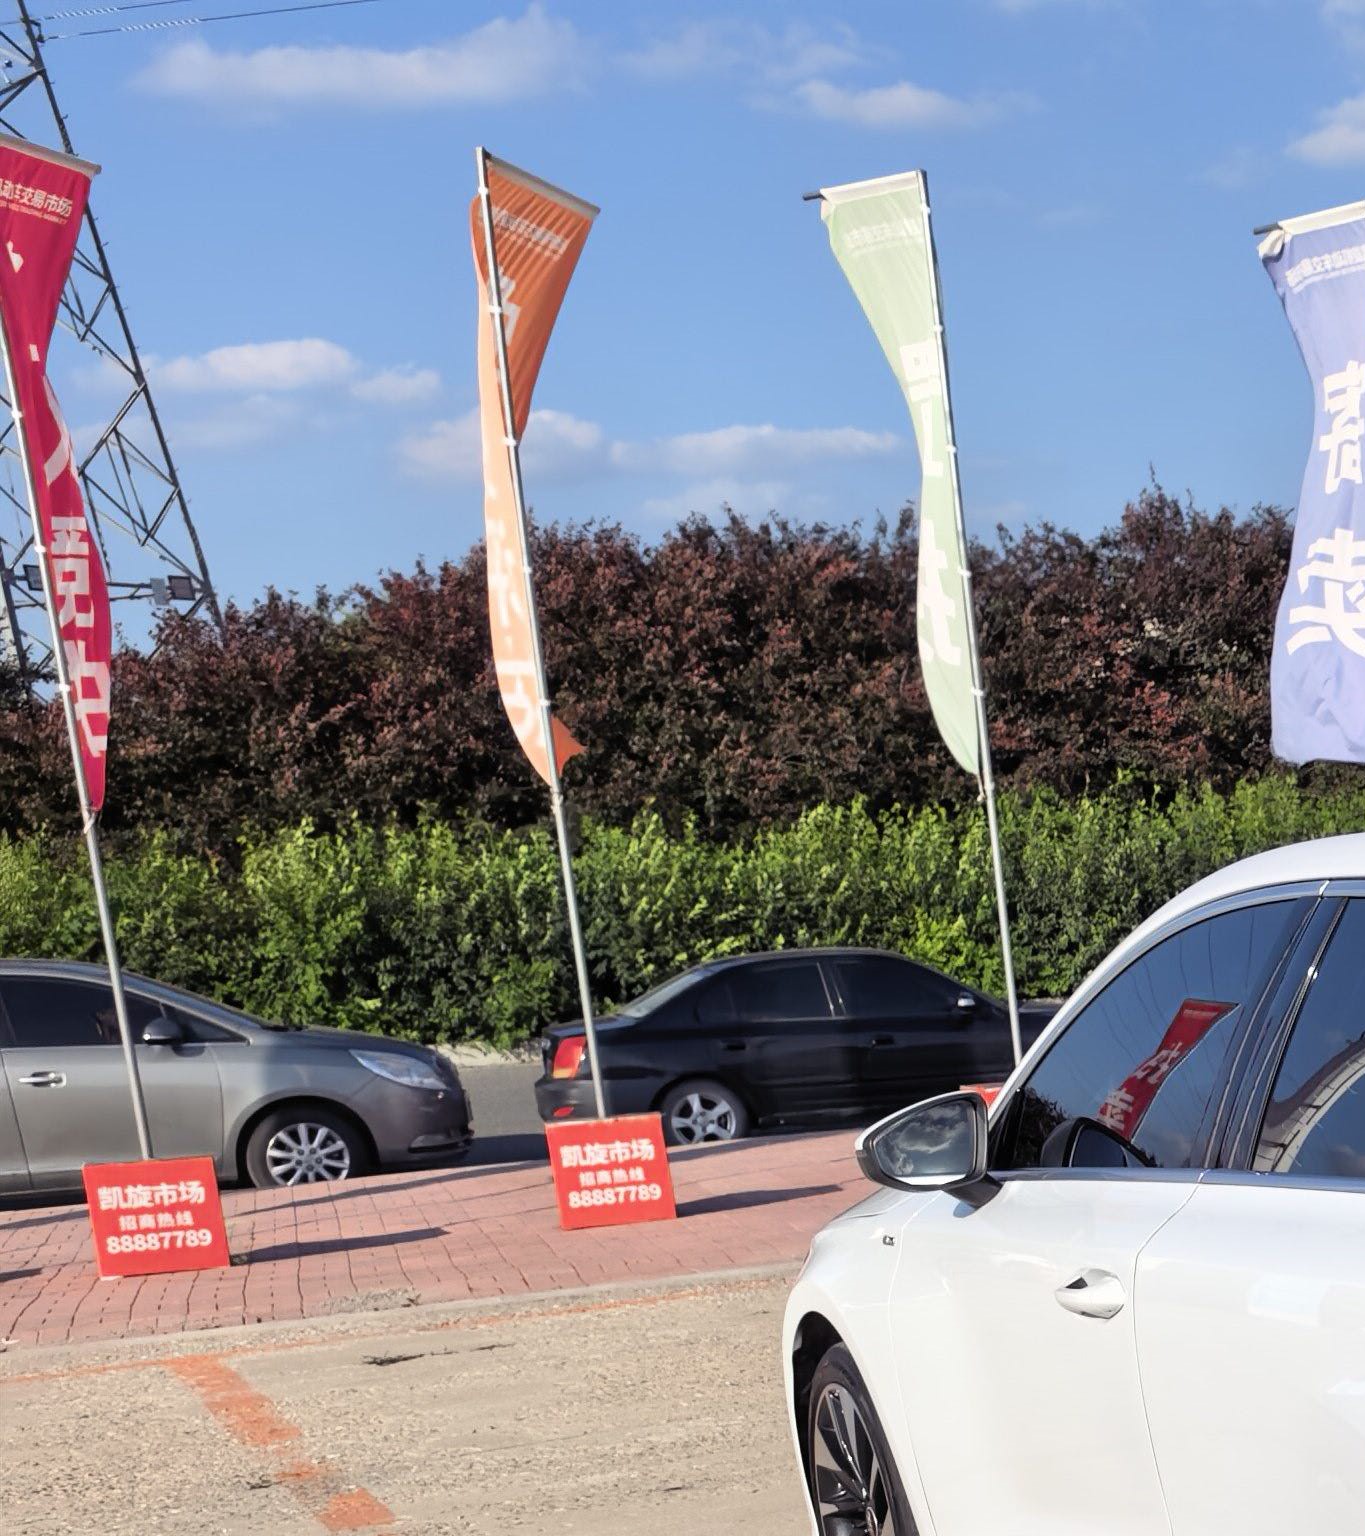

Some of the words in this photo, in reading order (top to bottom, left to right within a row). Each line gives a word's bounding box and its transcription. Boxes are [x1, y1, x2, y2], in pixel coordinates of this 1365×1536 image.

[560, 1138, 655, 1168] 凯旋市场
[97, 1180, 205, 1211] 凯旋市场
[568, 1184, 662, 1208] 88887789
[106, 1229, 212, 1254] 88887789
